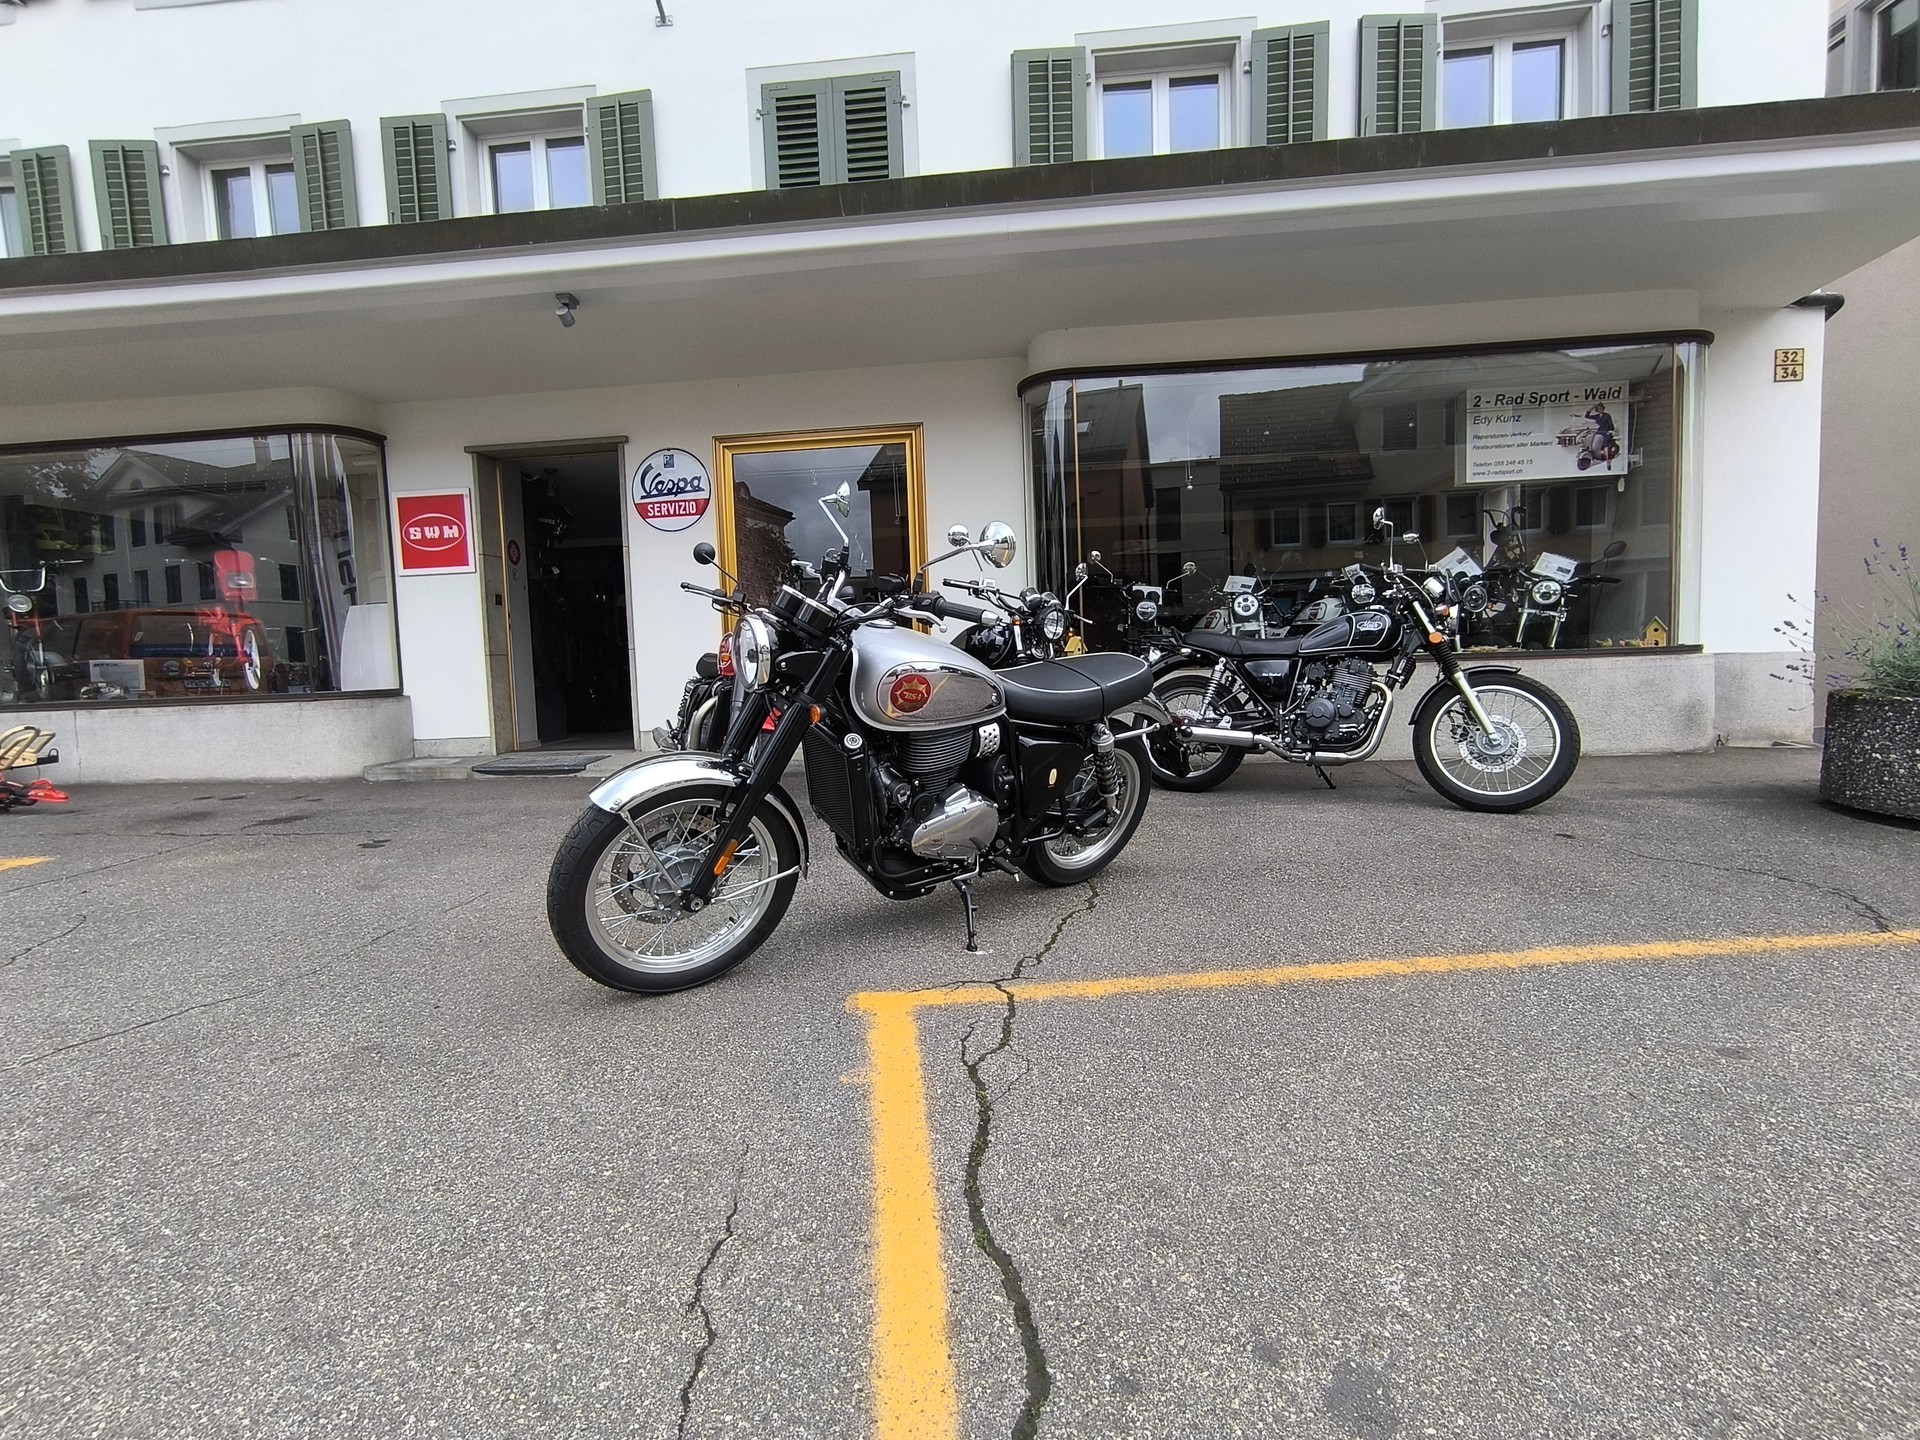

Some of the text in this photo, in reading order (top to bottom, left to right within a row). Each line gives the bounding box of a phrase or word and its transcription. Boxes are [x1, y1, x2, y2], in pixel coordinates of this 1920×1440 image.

[1781, 351, 1798, 363] 32
[1781, 367, 1798, 379] 34
[1473, 395, 1482, 408] 2
[1494, 393, 1524, 406] Rad
[1528, 390, 1570, 406] Sport
[1584, 386, 1622, 401] Wald
[1473, 413, 1522, 426] Edy Kunz
[640, 463, 705, 499] Vespa
[647, 501, 697, 516] SERVIZIO
[409, 525, 460, 540] SWM
